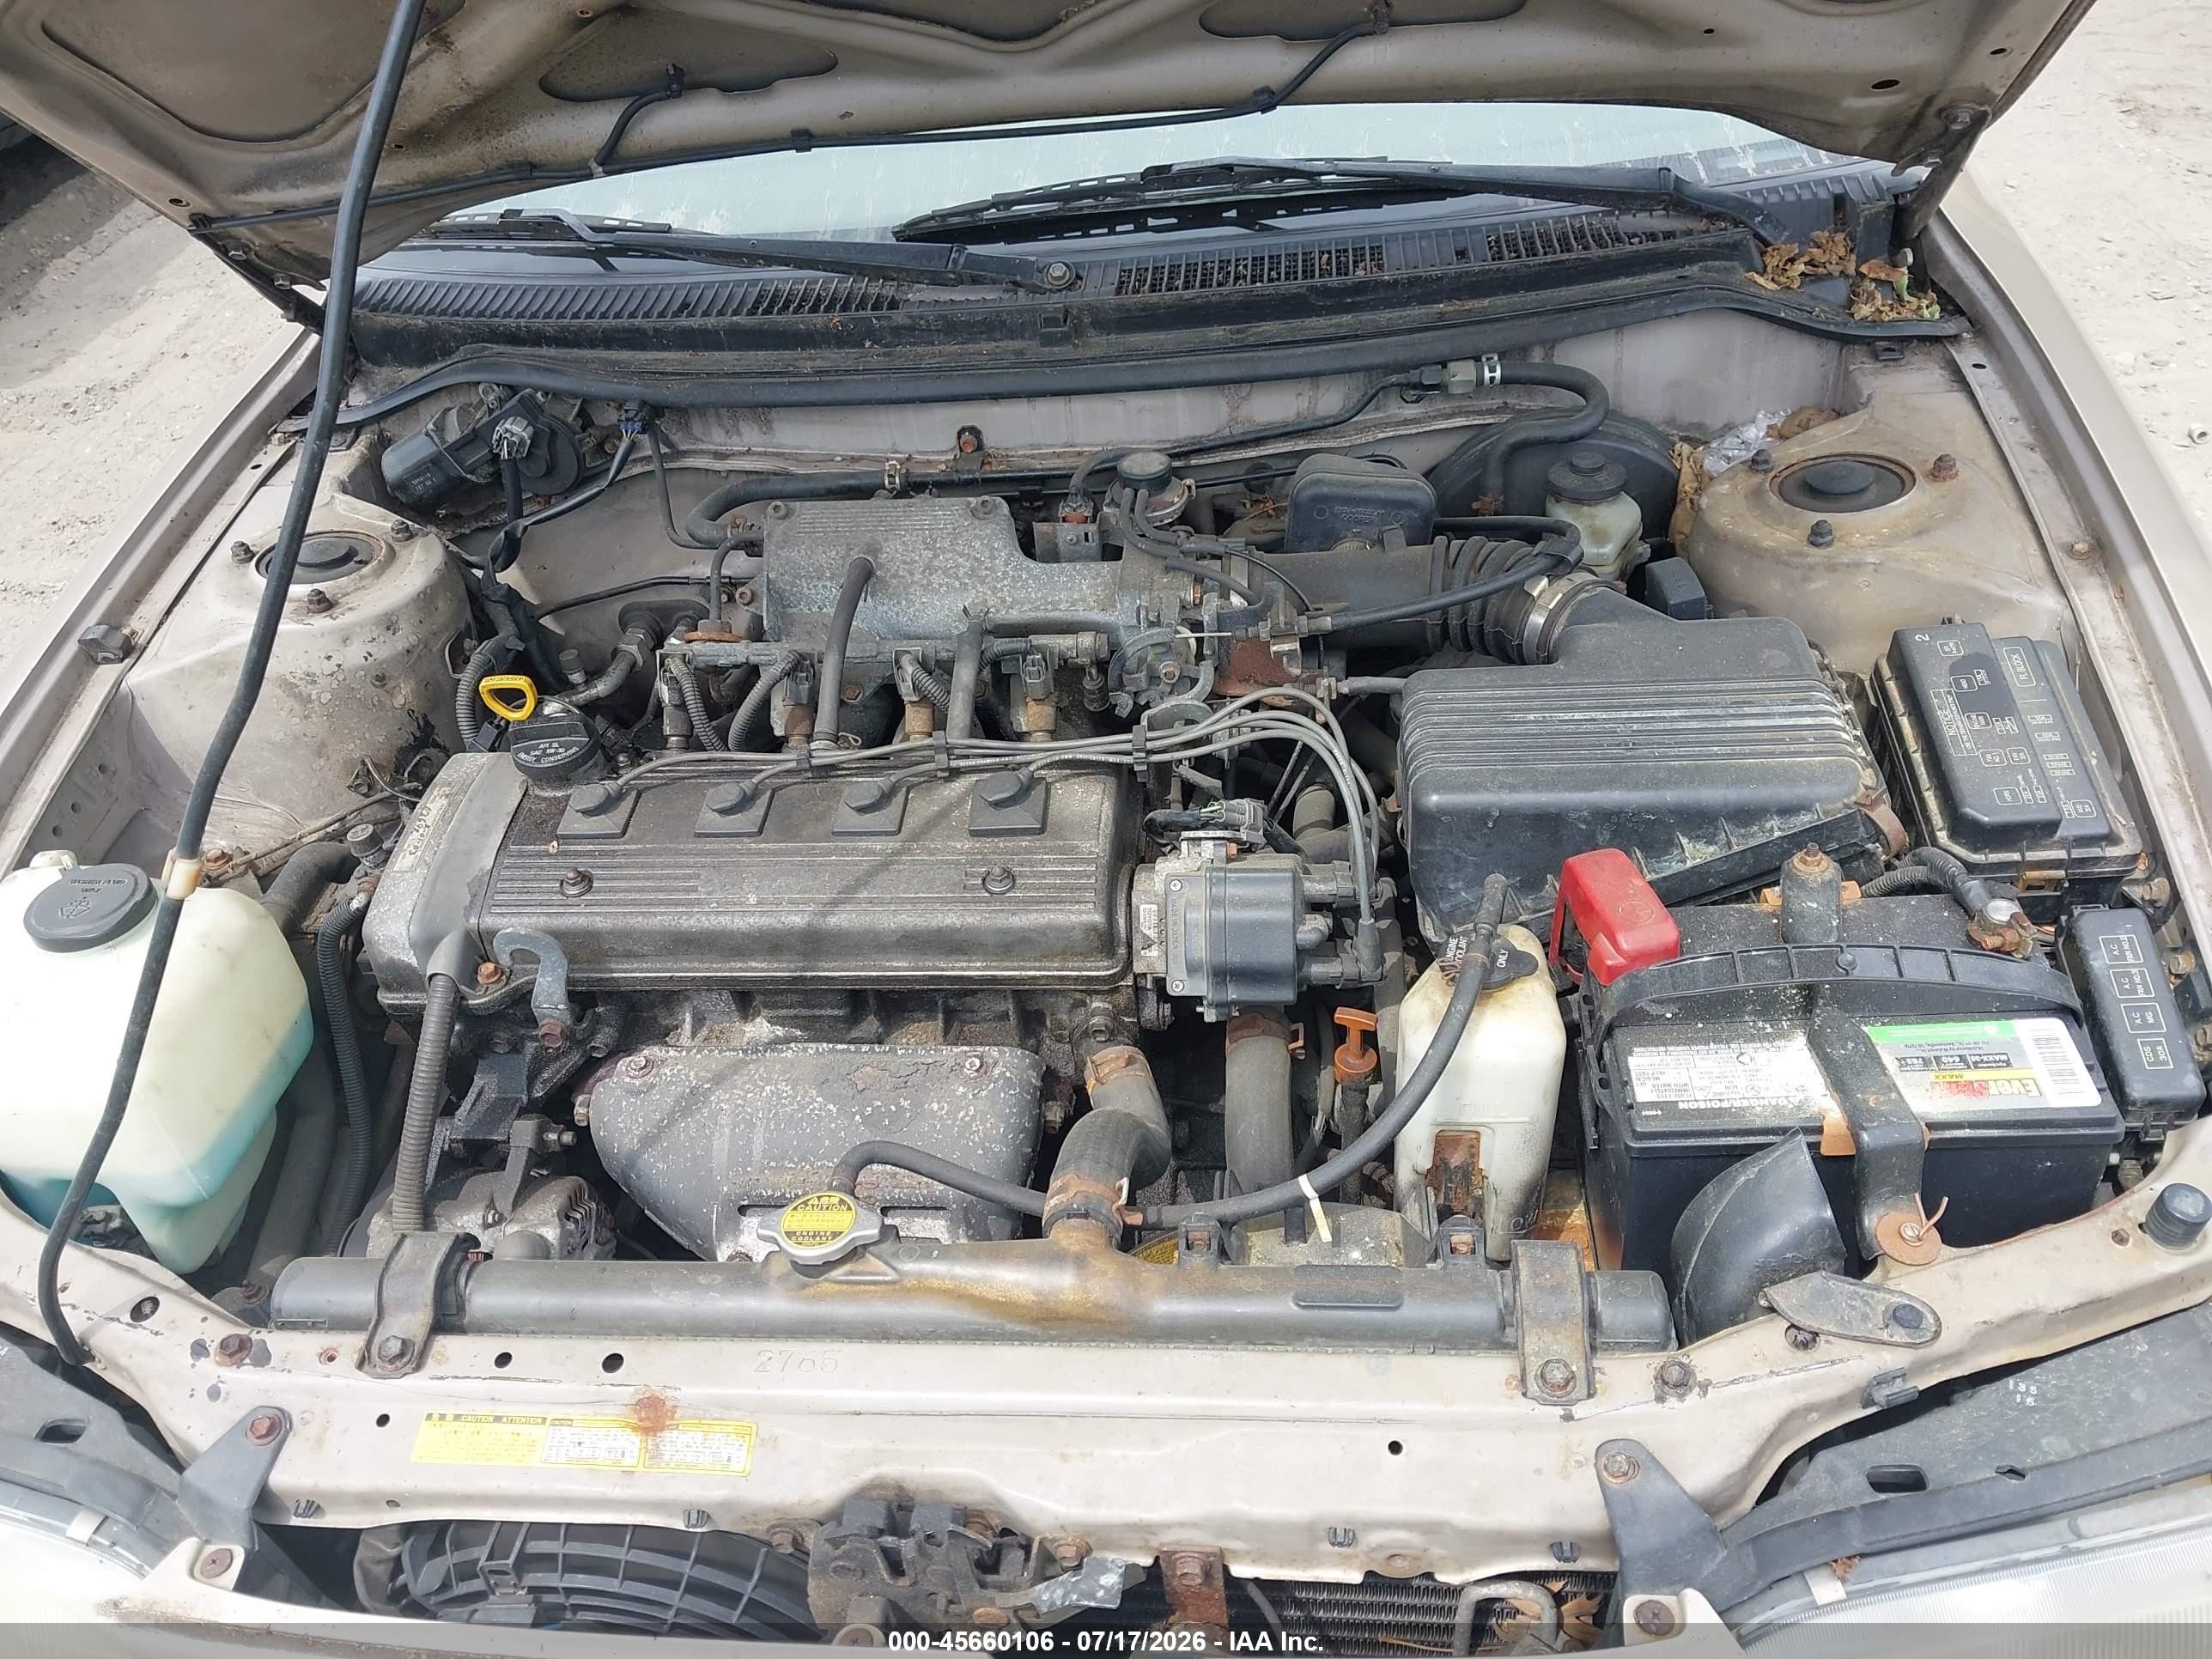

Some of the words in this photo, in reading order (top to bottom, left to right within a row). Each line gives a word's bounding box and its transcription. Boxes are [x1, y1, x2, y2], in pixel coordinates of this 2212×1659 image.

[1915, 633, 1929, 641] 2
[2010, 653, 2027, 672] BLOCK
[1939, 708, 1956, 736] NOTICE
[517, 752, 538, 763] ENERGY
[541, 746, 580, 763] CONSERVING
[1445, 936, 1459, 962] NGINE
[1455, 935, 1468, 963] OOLANT
[2126, 951, 2136, 963] FAN
[1496, 948, 1510, 968] ONLY
[2136, 984, 2147, 997] FAN
[2145, 1012, 2155, 1024] MG
[2142, 1046, 2154, 1062] CDS
[2156, 1045, 2168, 1062] 30A
[1934, 1073, 1964, 1081] MAXX
[1678, 1097, 1790, 1109] DANGER/POISON
[460, 1415, 495, 1424] CAUTION
[501, 1417, 544, 1425] ATTENTION
